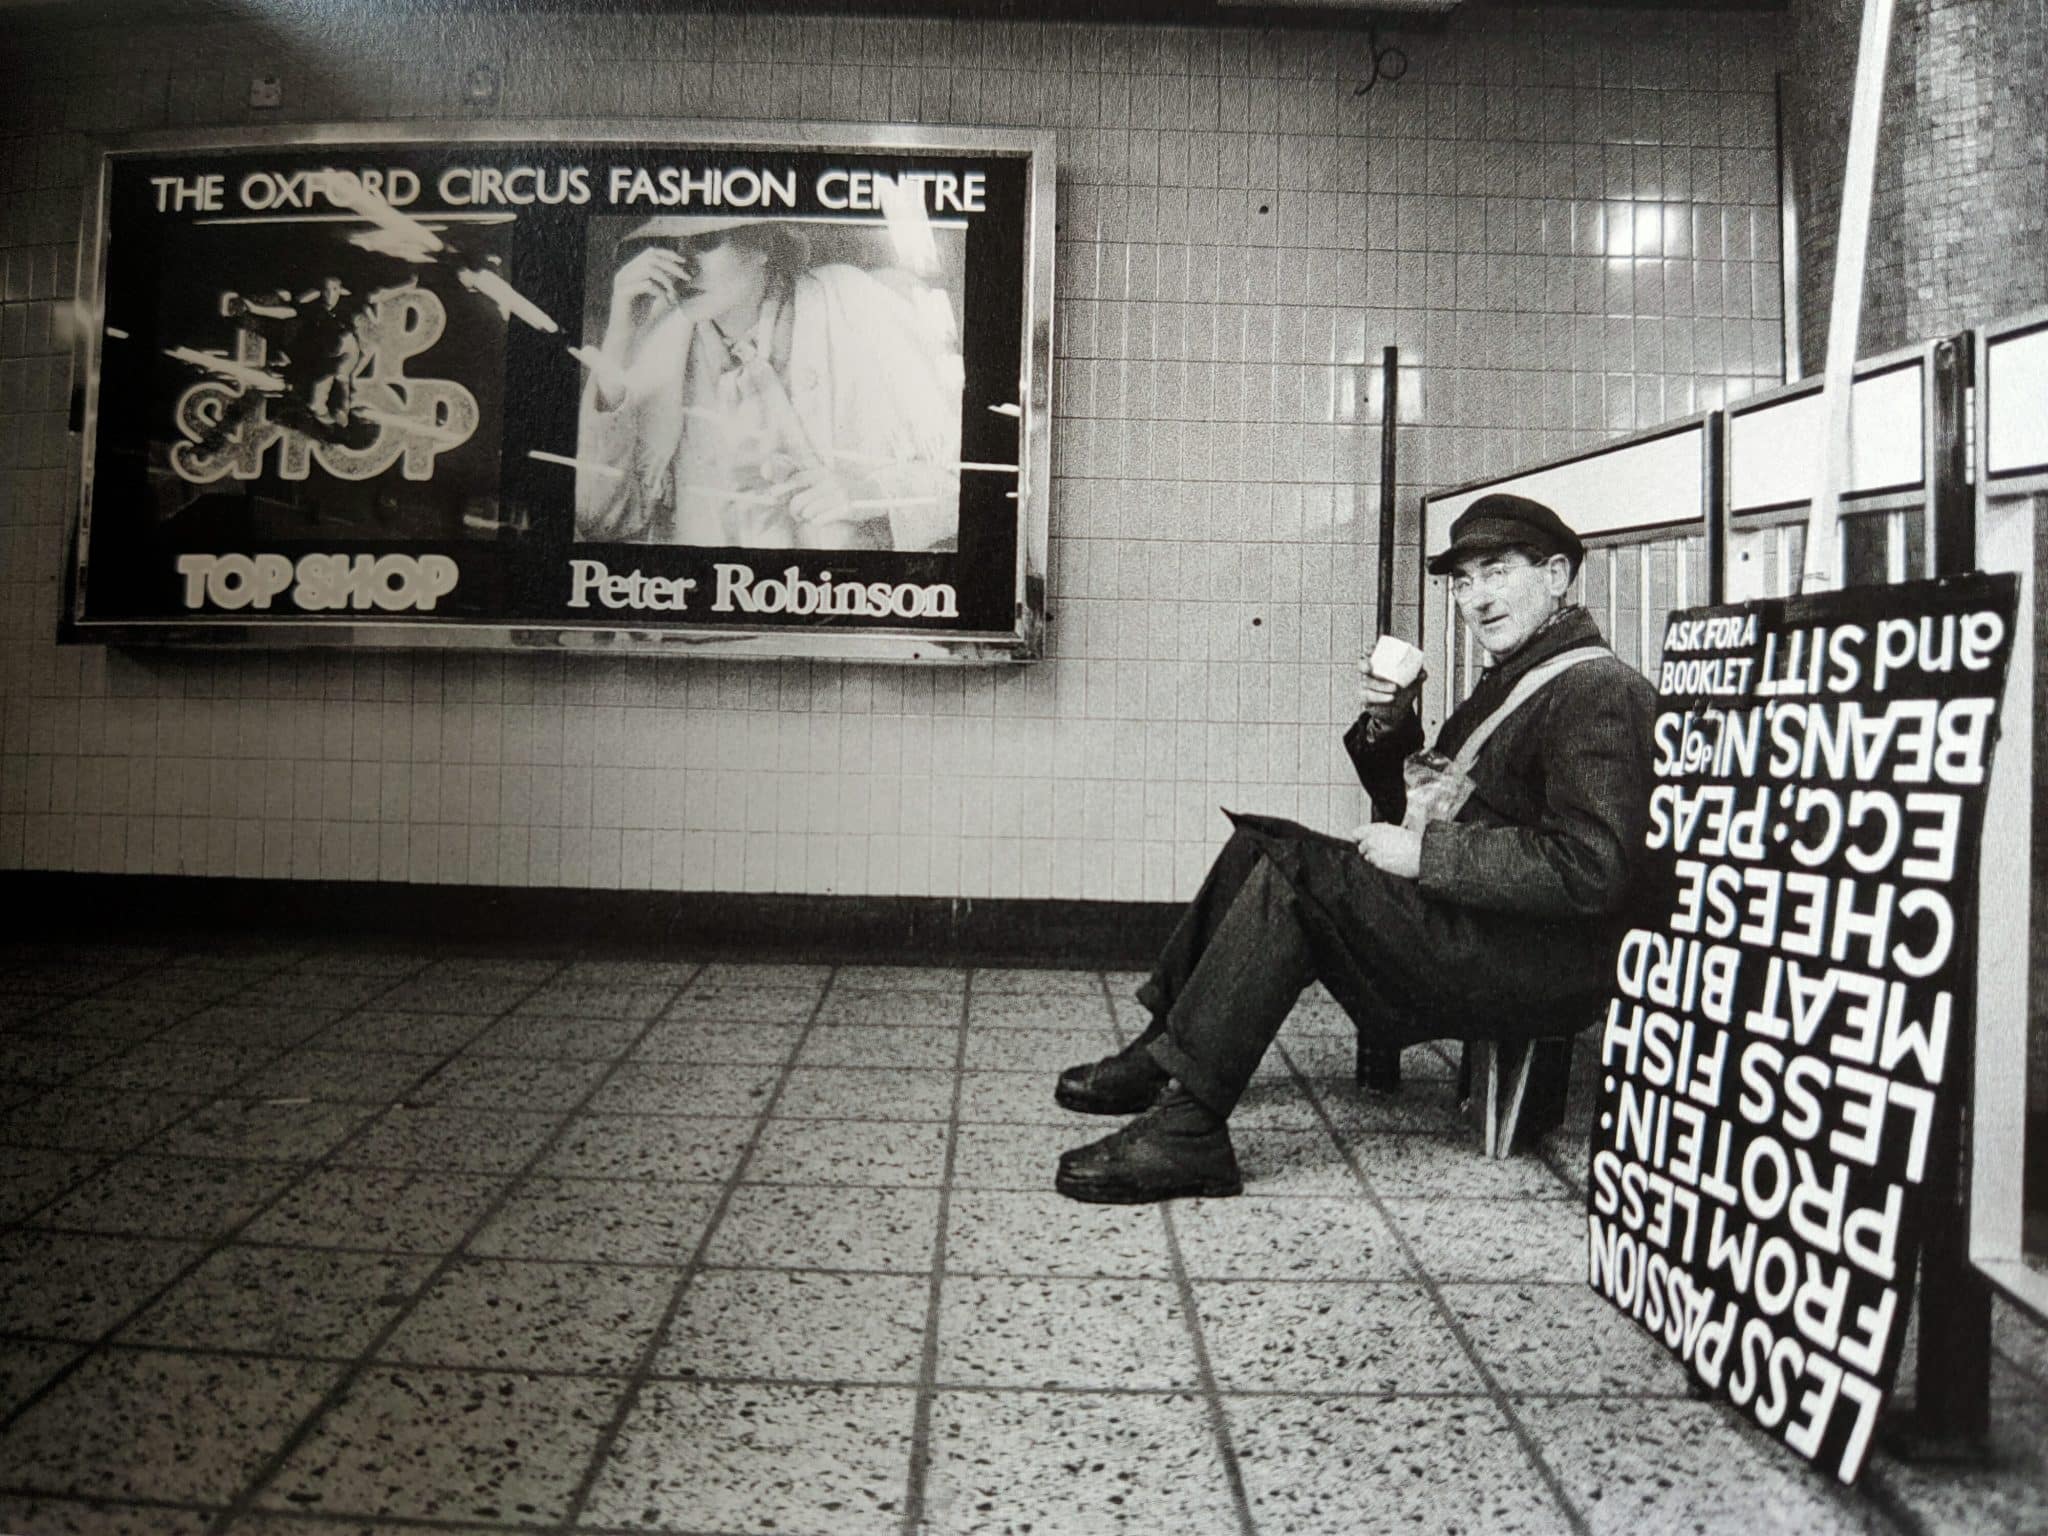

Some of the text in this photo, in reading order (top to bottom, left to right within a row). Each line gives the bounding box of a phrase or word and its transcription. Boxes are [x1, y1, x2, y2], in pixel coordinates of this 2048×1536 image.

[151, 167, 987, 213] THE OXFORD CIRCUS FASHION CENTRE
[177, 553, 460, 610] TOP SHOP
[567, 559, 959, 618] Peter Robinson
[1659, 657, 1755, 696] BOOKLET
[1664, 614, 1757, 651] ASK FOR A
[1873, 611, 2004, 693] and
[1765, 697, 1996, 785] BEANS,
[1645, 783, 1962, 882] EGG; PEAS
[1670, 859, 1954, 978] CHEESE
[1616, 928, 1952, 1084] MEAT BIRD
[1602, 998, 1936, 1183] LESS FISH
[1600, 1075, 1903, 1280] PROTEIN:
[1593, 1150, 1897, 1375] FROM LESS
[1589, 1214, 1882, 1485] LESS PASSION
